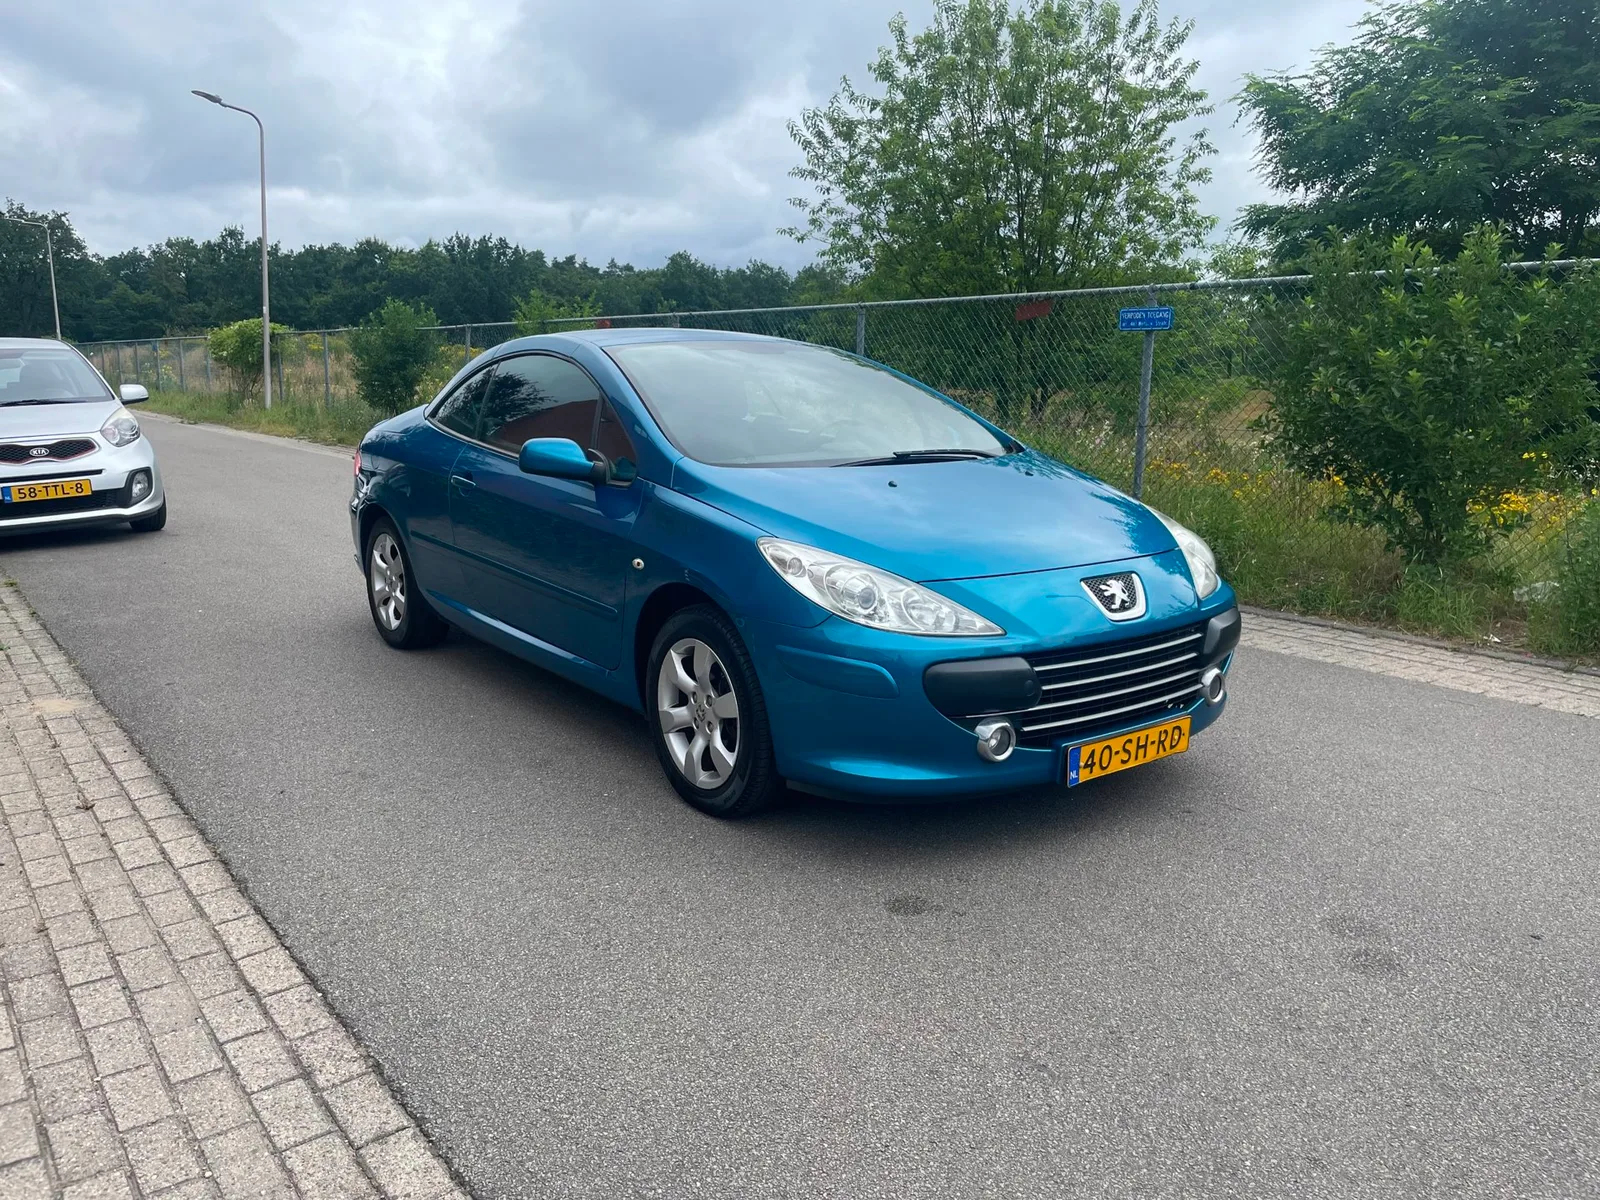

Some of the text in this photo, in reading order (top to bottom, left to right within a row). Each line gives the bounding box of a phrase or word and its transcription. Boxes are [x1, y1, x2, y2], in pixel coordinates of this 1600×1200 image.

[17, 482, 84, 500] 58-TTL-8
[1083, 725, 1183, 775] 40-SH-RD
[1070, 770, 1078, 780] NL
